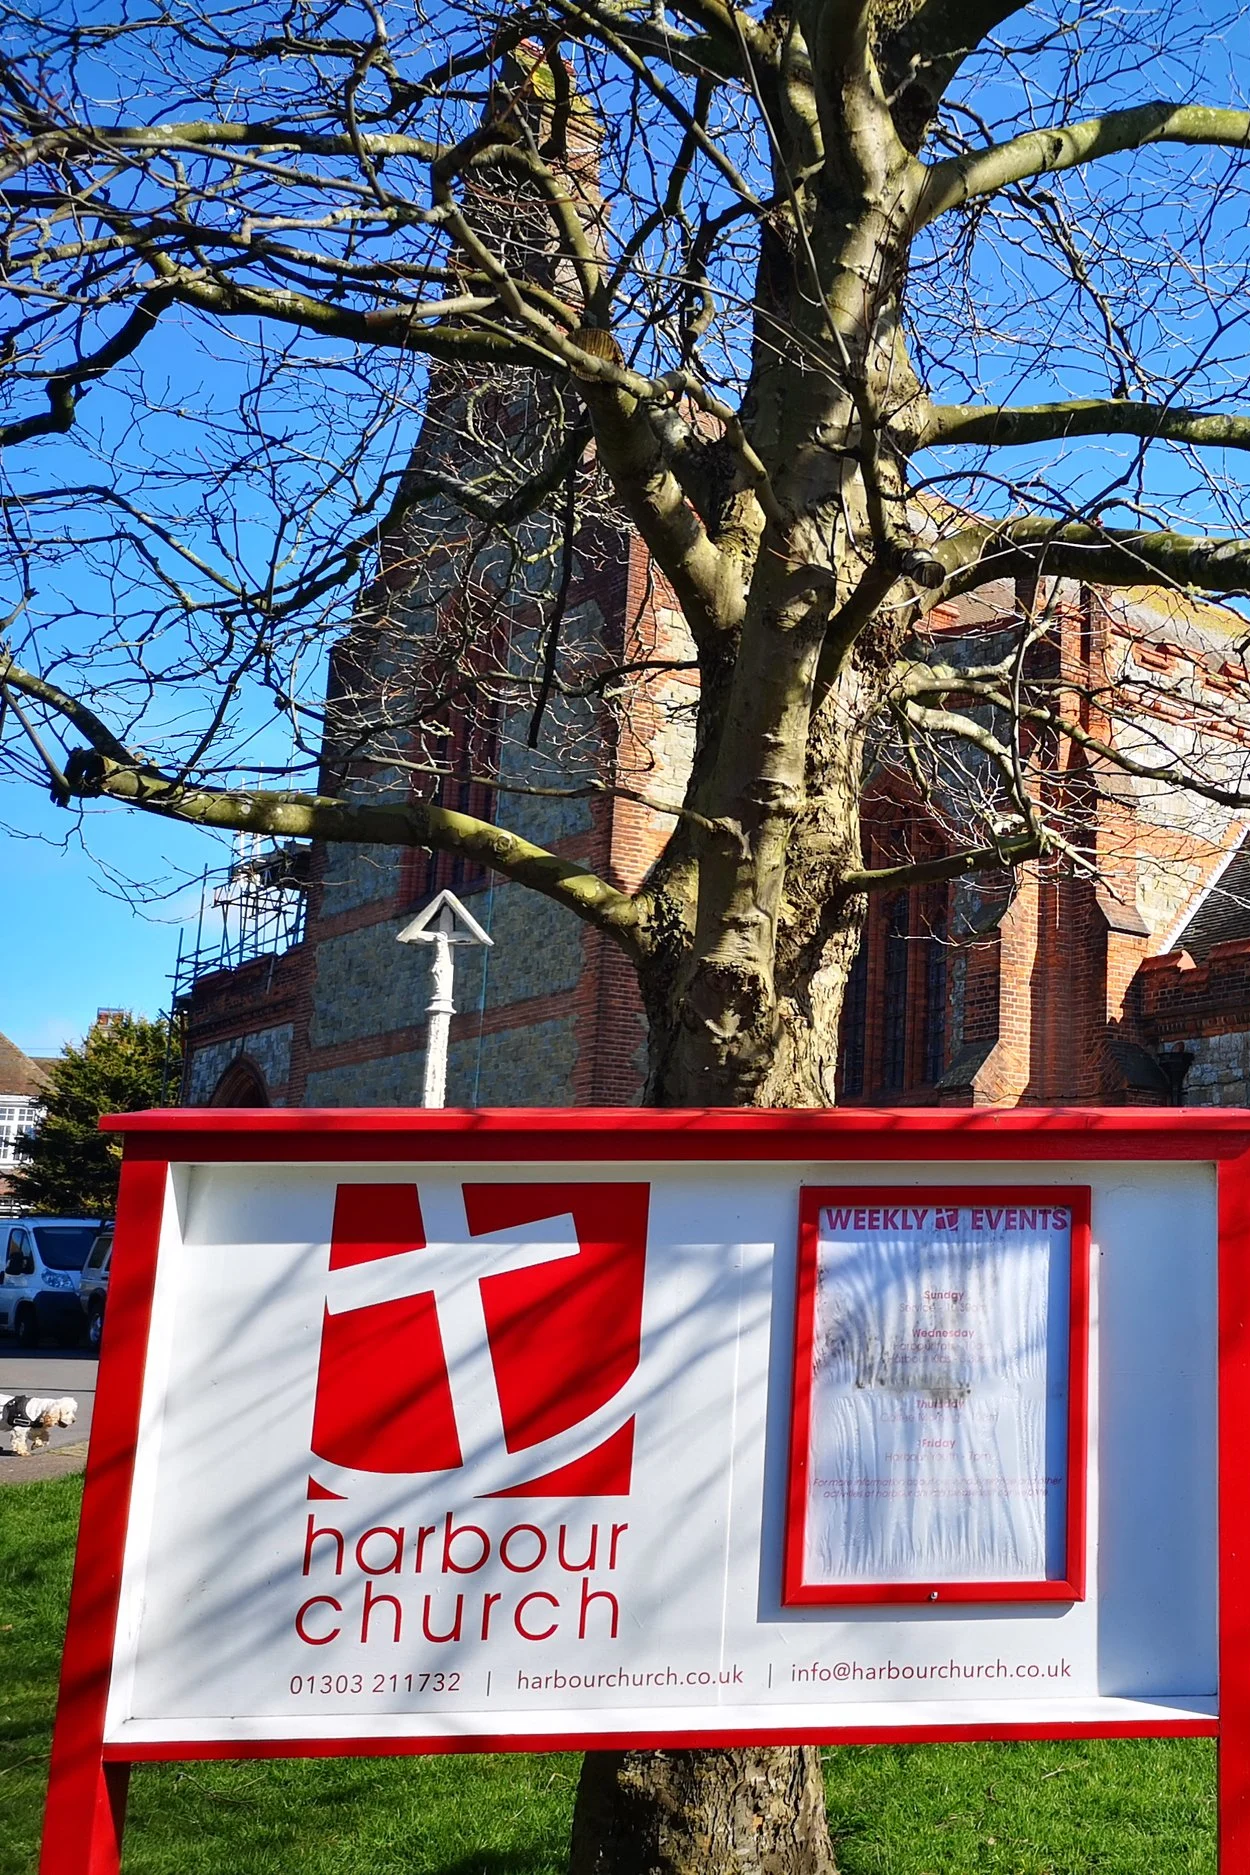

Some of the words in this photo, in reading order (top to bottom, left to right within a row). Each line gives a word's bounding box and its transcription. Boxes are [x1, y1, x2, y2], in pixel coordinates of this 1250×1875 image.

[826, 1208, 928, 1231] WEEKLY
[971, 1208, 1067, 1231] EVENTS
[923, 1290, 964, 1302] Sunday
[912, 1328, 974, 1339] Wednesday
[916, 1399, 964, 1410] Thursday
[922, 1438, 956, 1449] Friday
[303, 1513, 629, 1576] harbour
[295, 1577, 620, 1646] church
[289, 1674, 363, 1695] 01303
[372, 1672, 462, 1694] 211732
[516, 1664, 744, 1690] harbourchurch.co.uk
[790, 1658, 1072, 1682] info@harbourchurch.co.uk
